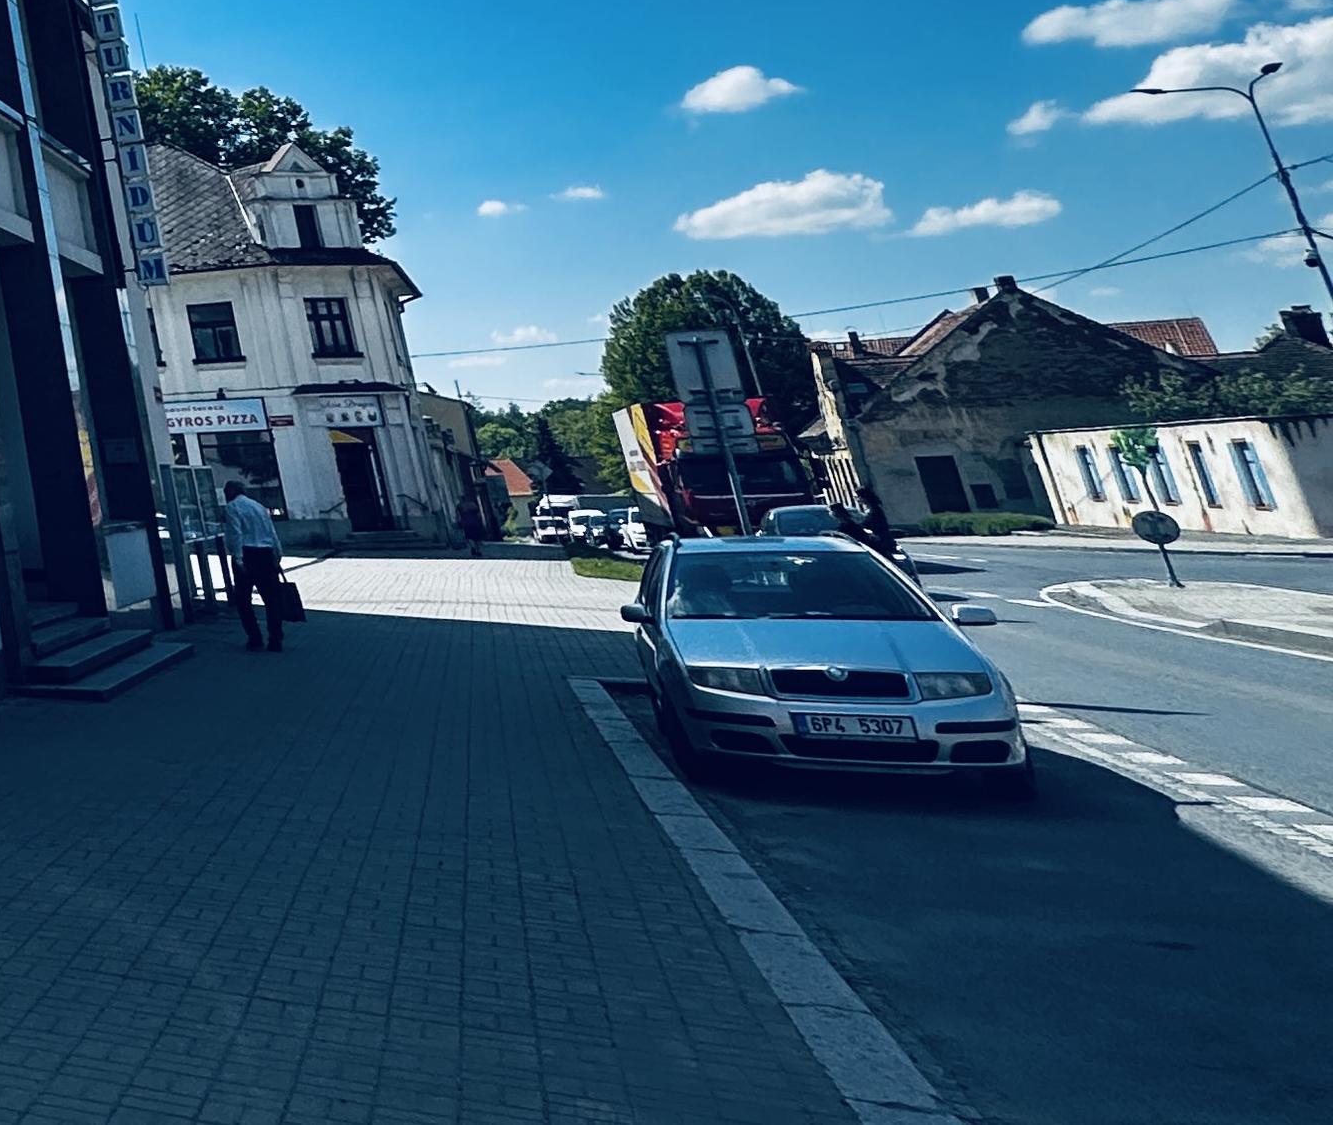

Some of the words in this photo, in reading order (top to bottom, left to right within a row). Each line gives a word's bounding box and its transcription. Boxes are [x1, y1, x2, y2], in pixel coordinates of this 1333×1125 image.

[167, 416, 214, 428] GYROS
[218, 414, 259, 426] PIZZA
[811, 717, 846, 733] 6P4
[858, 718, 903, 734] 5307
